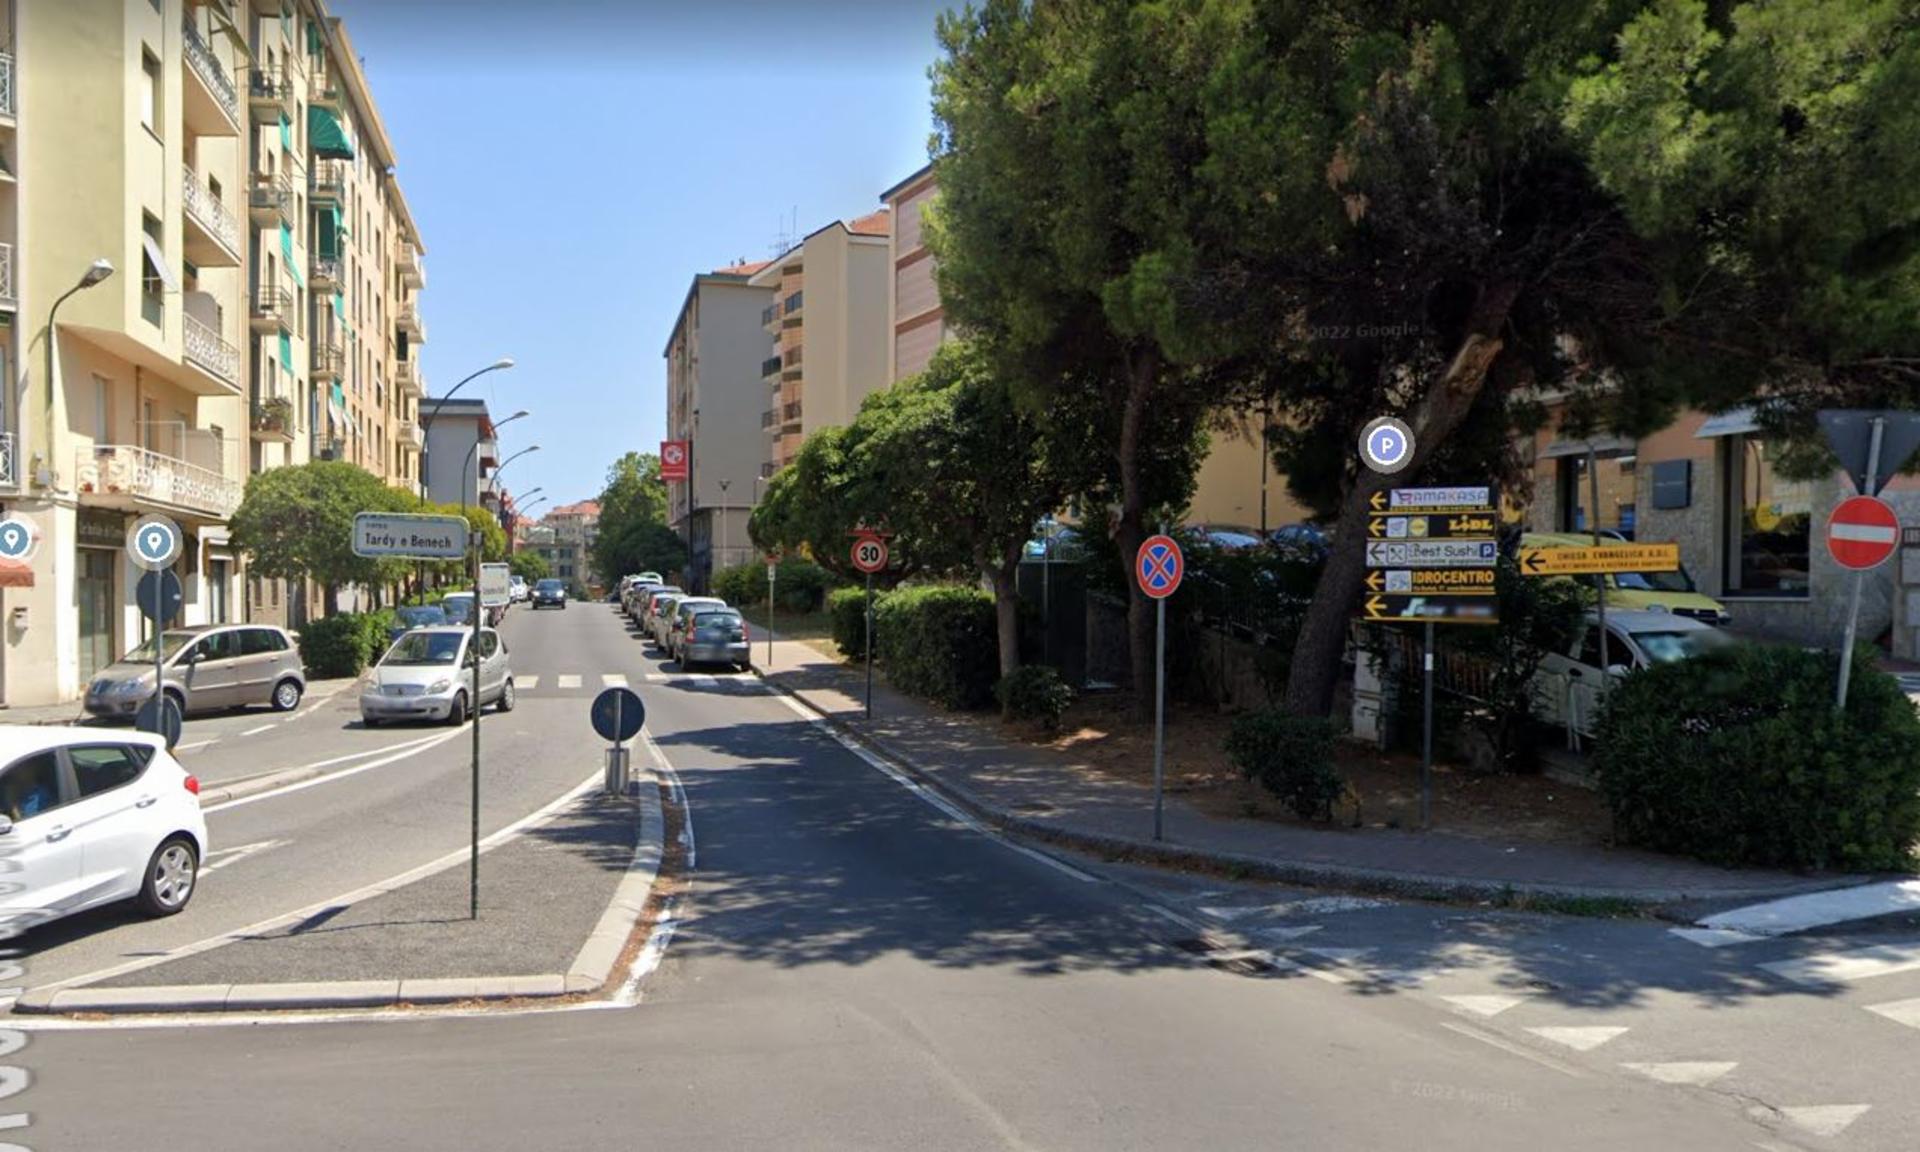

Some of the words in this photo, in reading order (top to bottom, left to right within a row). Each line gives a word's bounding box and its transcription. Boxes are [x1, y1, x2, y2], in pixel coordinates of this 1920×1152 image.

[365, 532, 396, 548] Tardy
[400, 537, 408, 546] e
[411, 534, 453, 549] Benech
[860, 546, 879, 562] 30
[1408, 543, 1441, 558] Best
[1444, 544, 1479, 557] Sushi
[1413, 570, 1495, 584] IDROCENTRO
